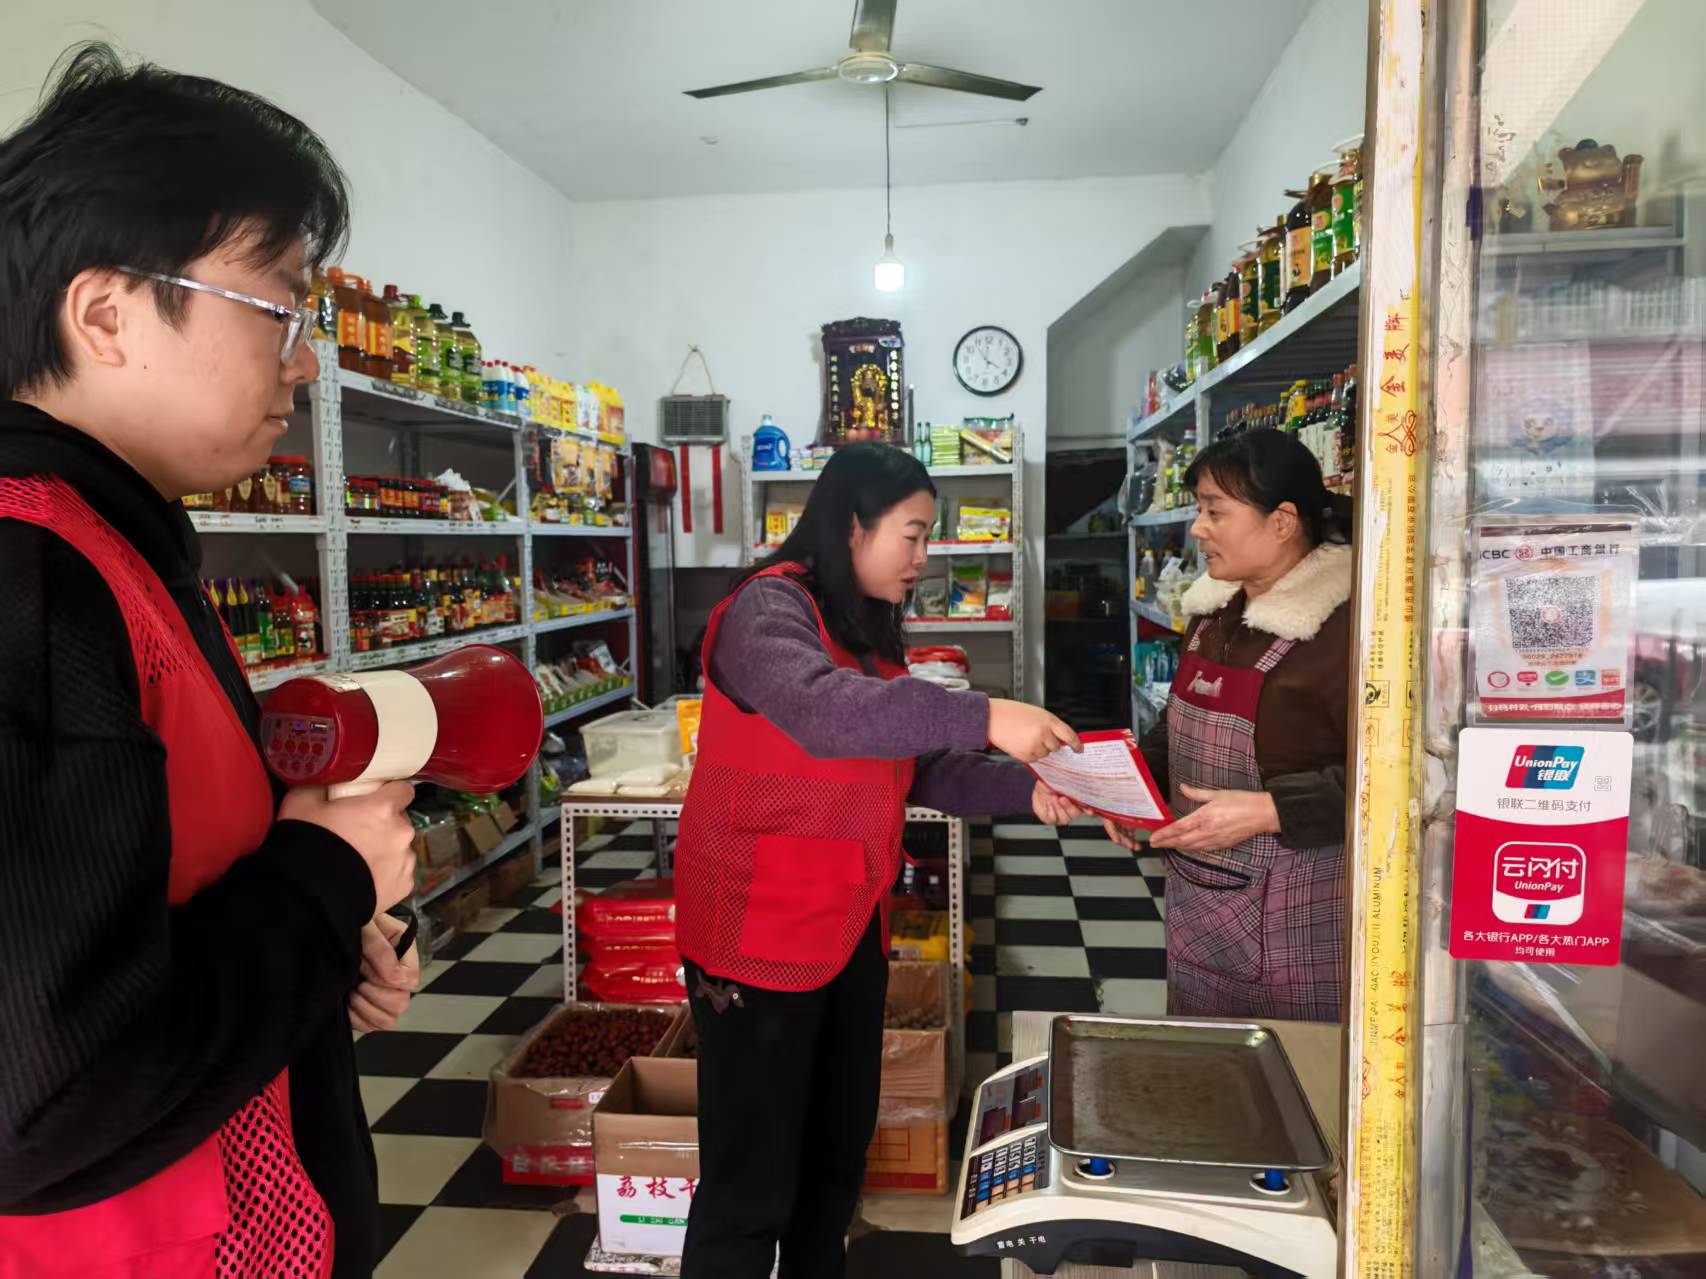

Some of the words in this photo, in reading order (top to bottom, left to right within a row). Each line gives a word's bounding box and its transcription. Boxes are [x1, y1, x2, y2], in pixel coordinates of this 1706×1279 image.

[1541, 543, 1620, 557] 中国工商银行
[1514, 755, 1578, 772] UnionPay
[1537, 770, 1572, 781] 银联
[1497, 797, 1591, 812] 银联二维码支付
[1502, 857, 1579, 879] 云闪付
[1514, 881, 1564, 893] UnionPay
[1463, 931, 1610, 947] 各大银行APP/各大热门APP
[1515, 947, 1555, 957] 均可使用
